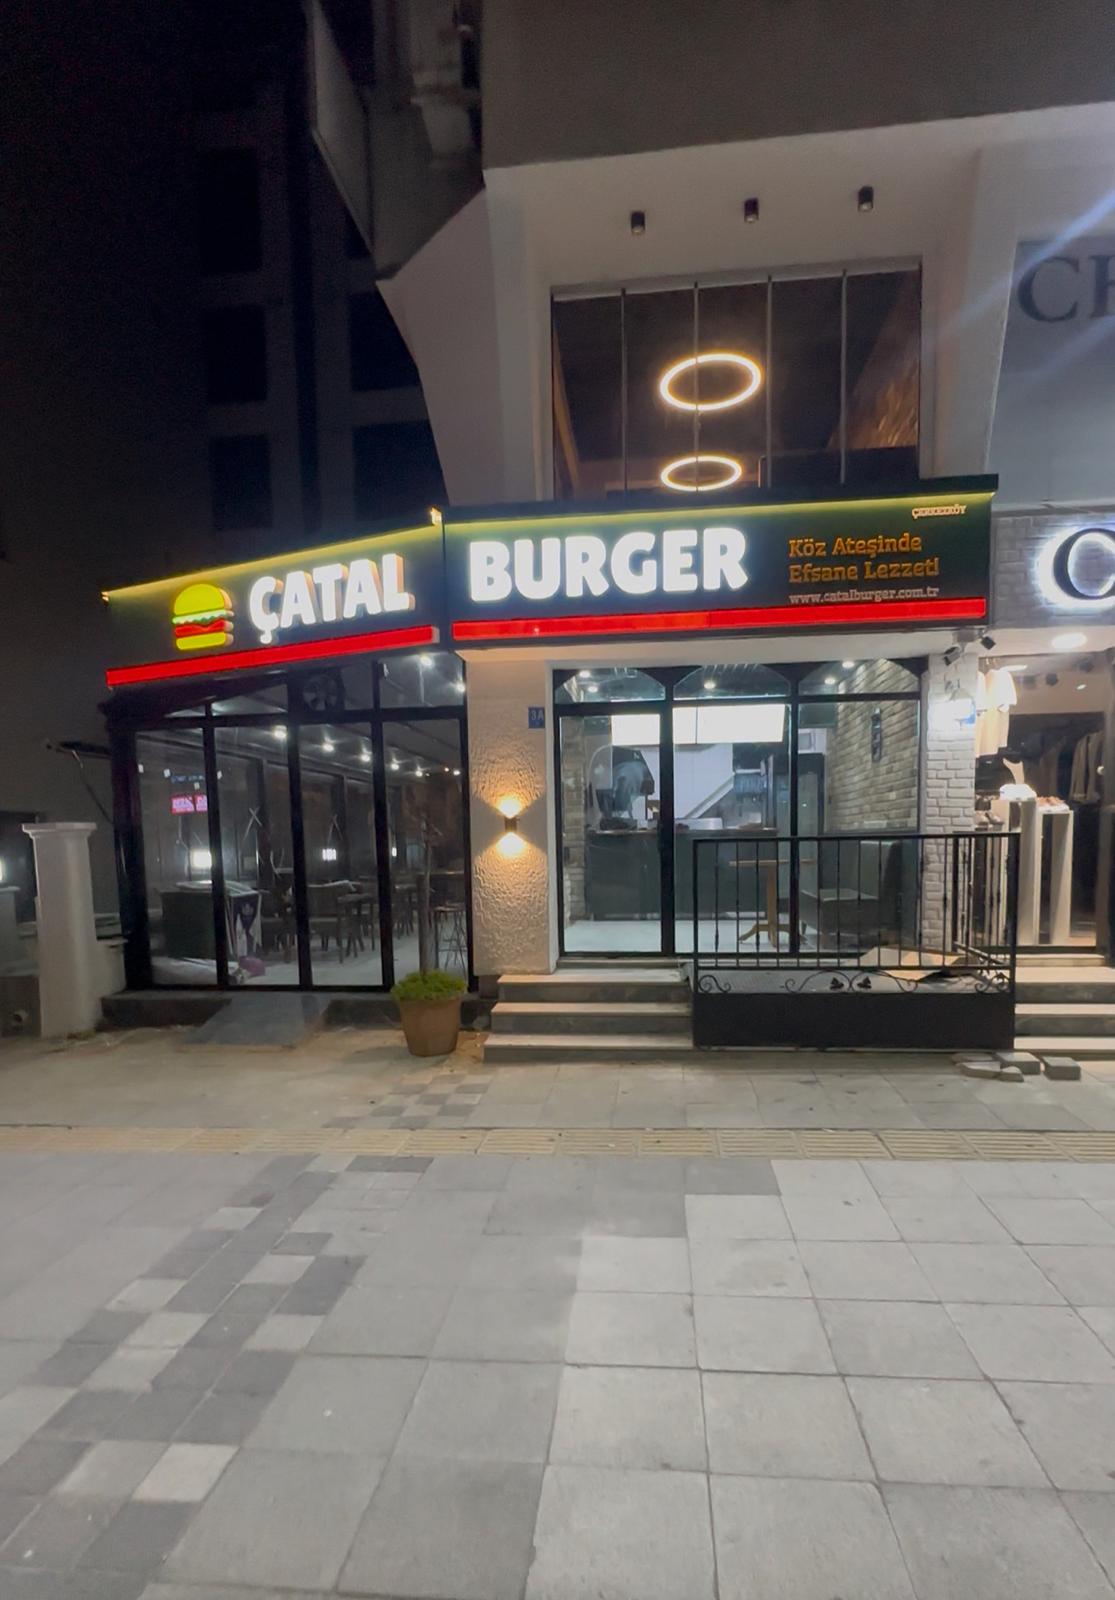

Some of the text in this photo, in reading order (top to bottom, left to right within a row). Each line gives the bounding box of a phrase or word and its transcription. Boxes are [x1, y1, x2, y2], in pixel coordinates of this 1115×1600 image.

[789, 533, 922, 557] Köz Ateşinde
[469, 527, 749, 602] BURGER
[789, 563, 858, 583] Efsane
[250, 553, 413, 645] ÇATAL
[789, 586, 939, 603] www.catalburger.com.tr
